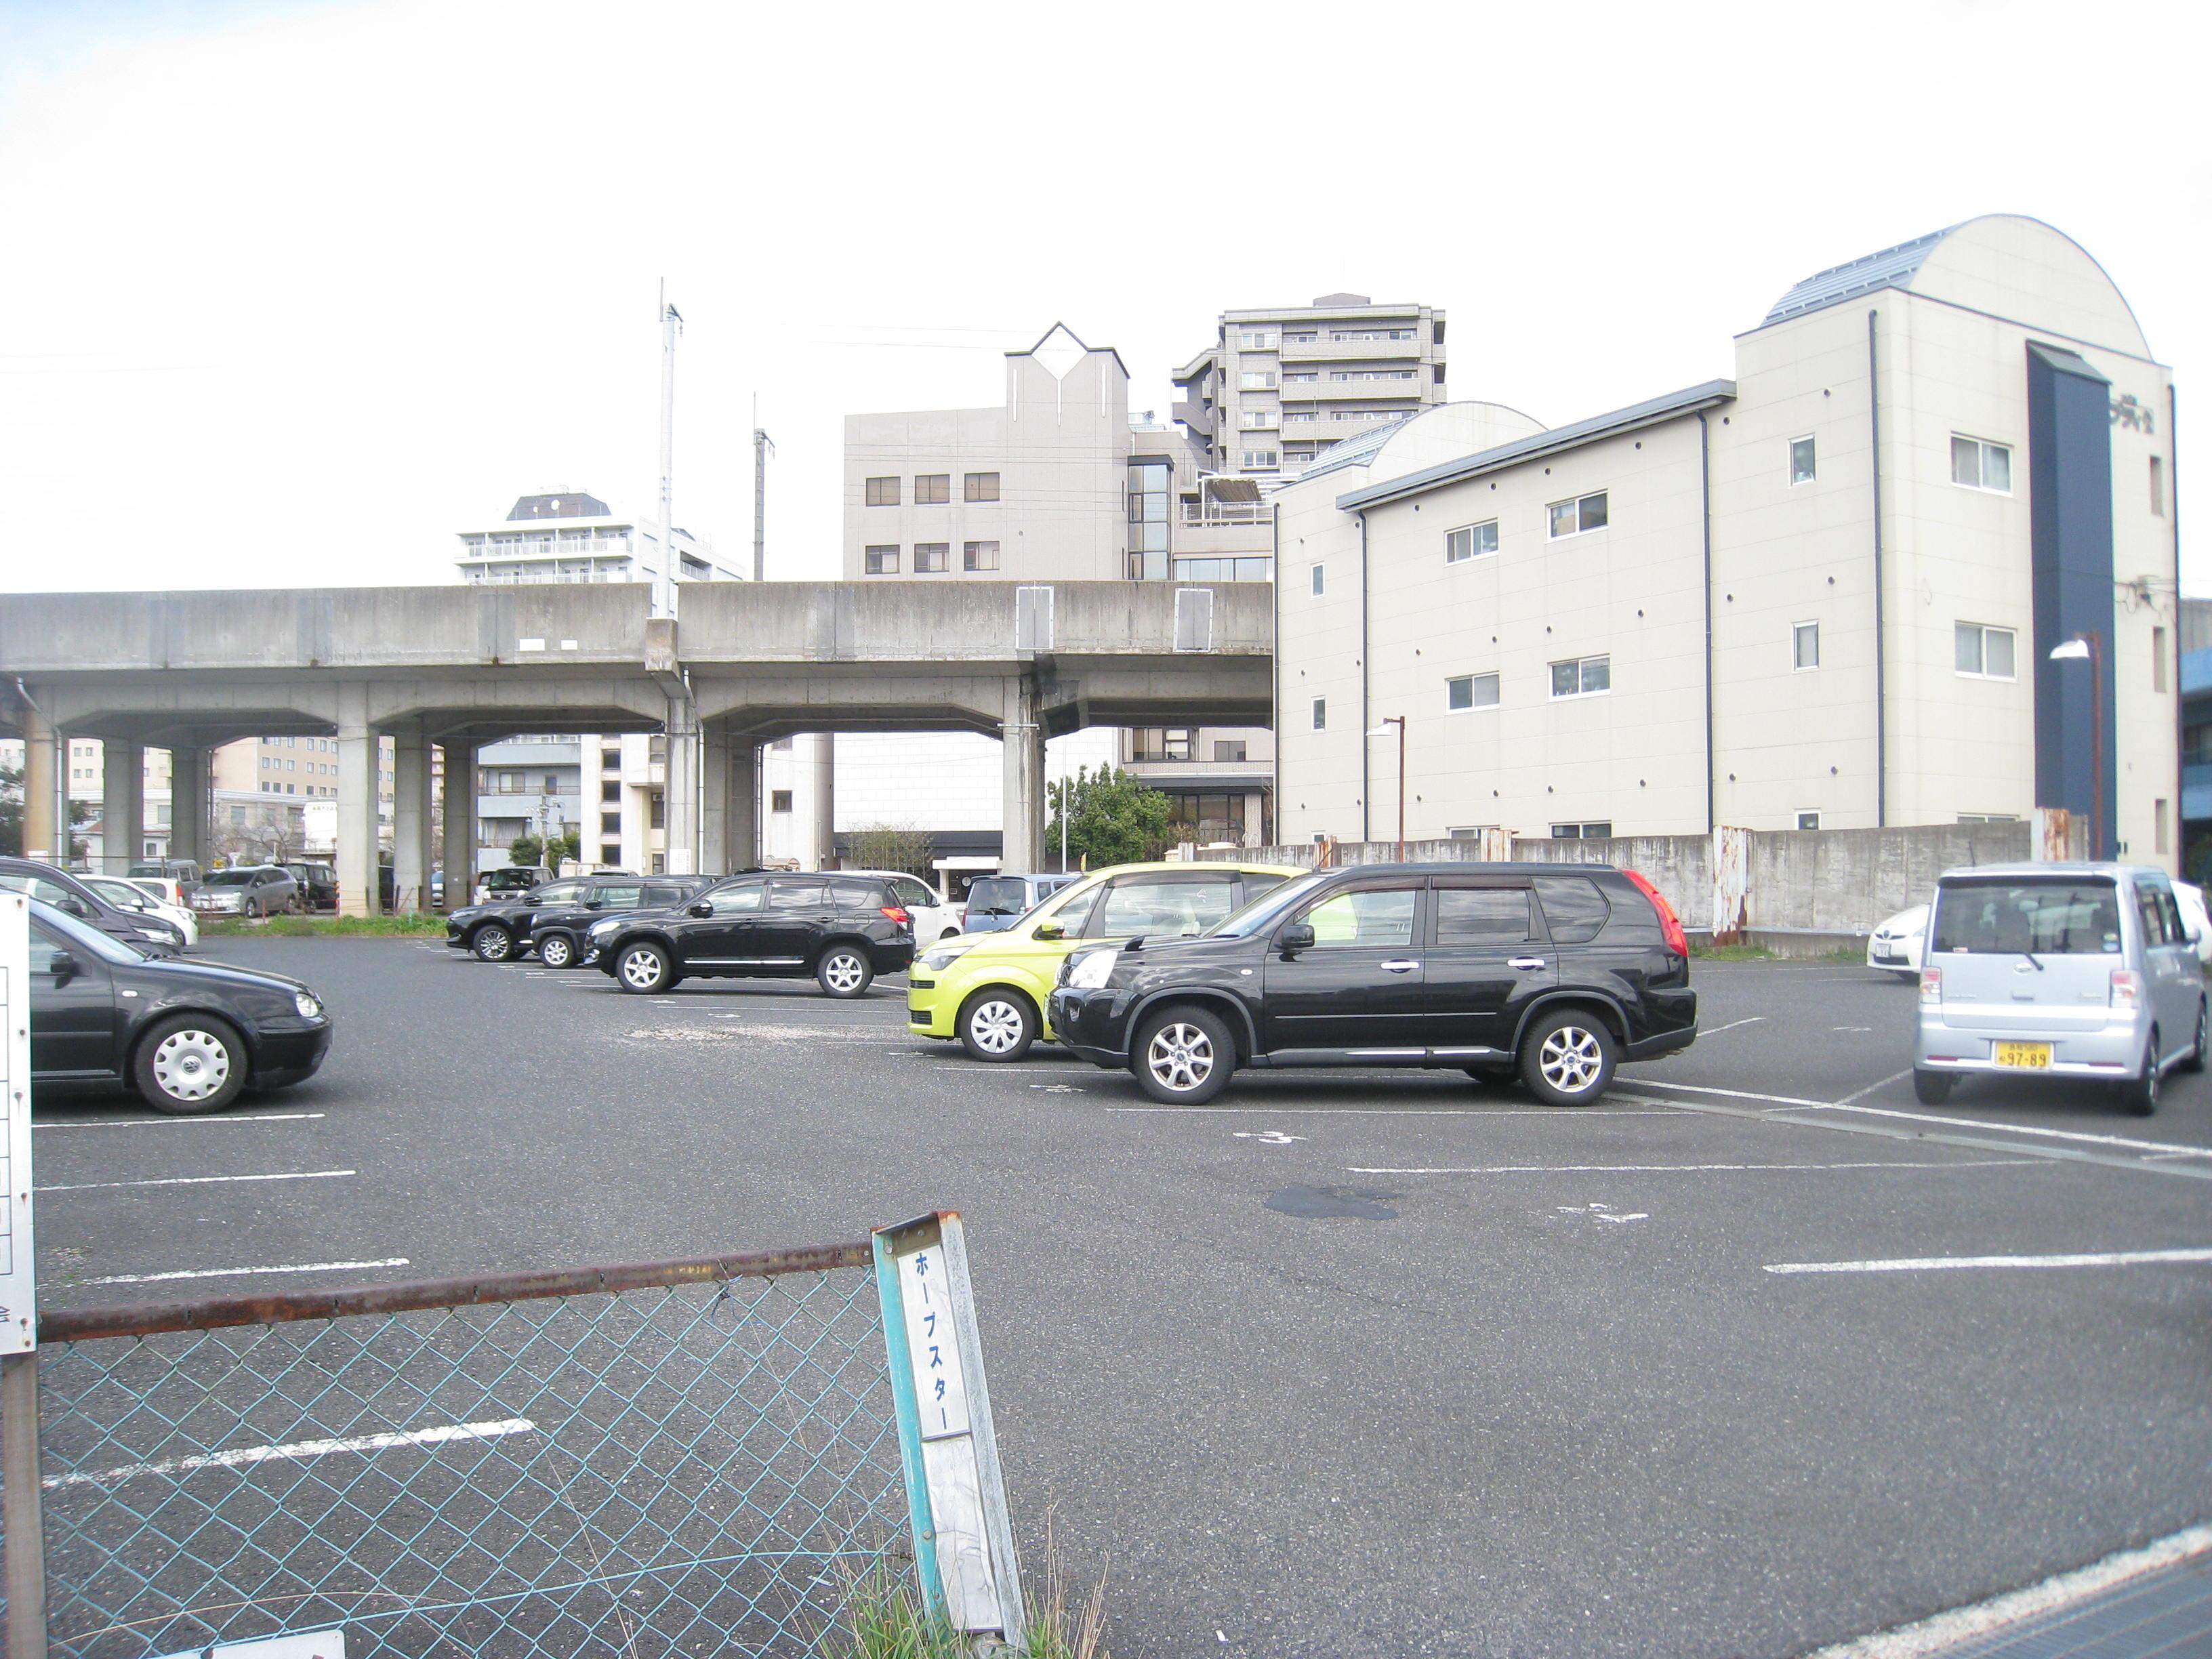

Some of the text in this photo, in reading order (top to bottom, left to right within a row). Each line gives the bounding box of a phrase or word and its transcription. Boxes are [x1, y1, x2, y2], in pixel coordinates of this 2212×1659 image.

[915, 1252, 947, 1430] ホープスター
